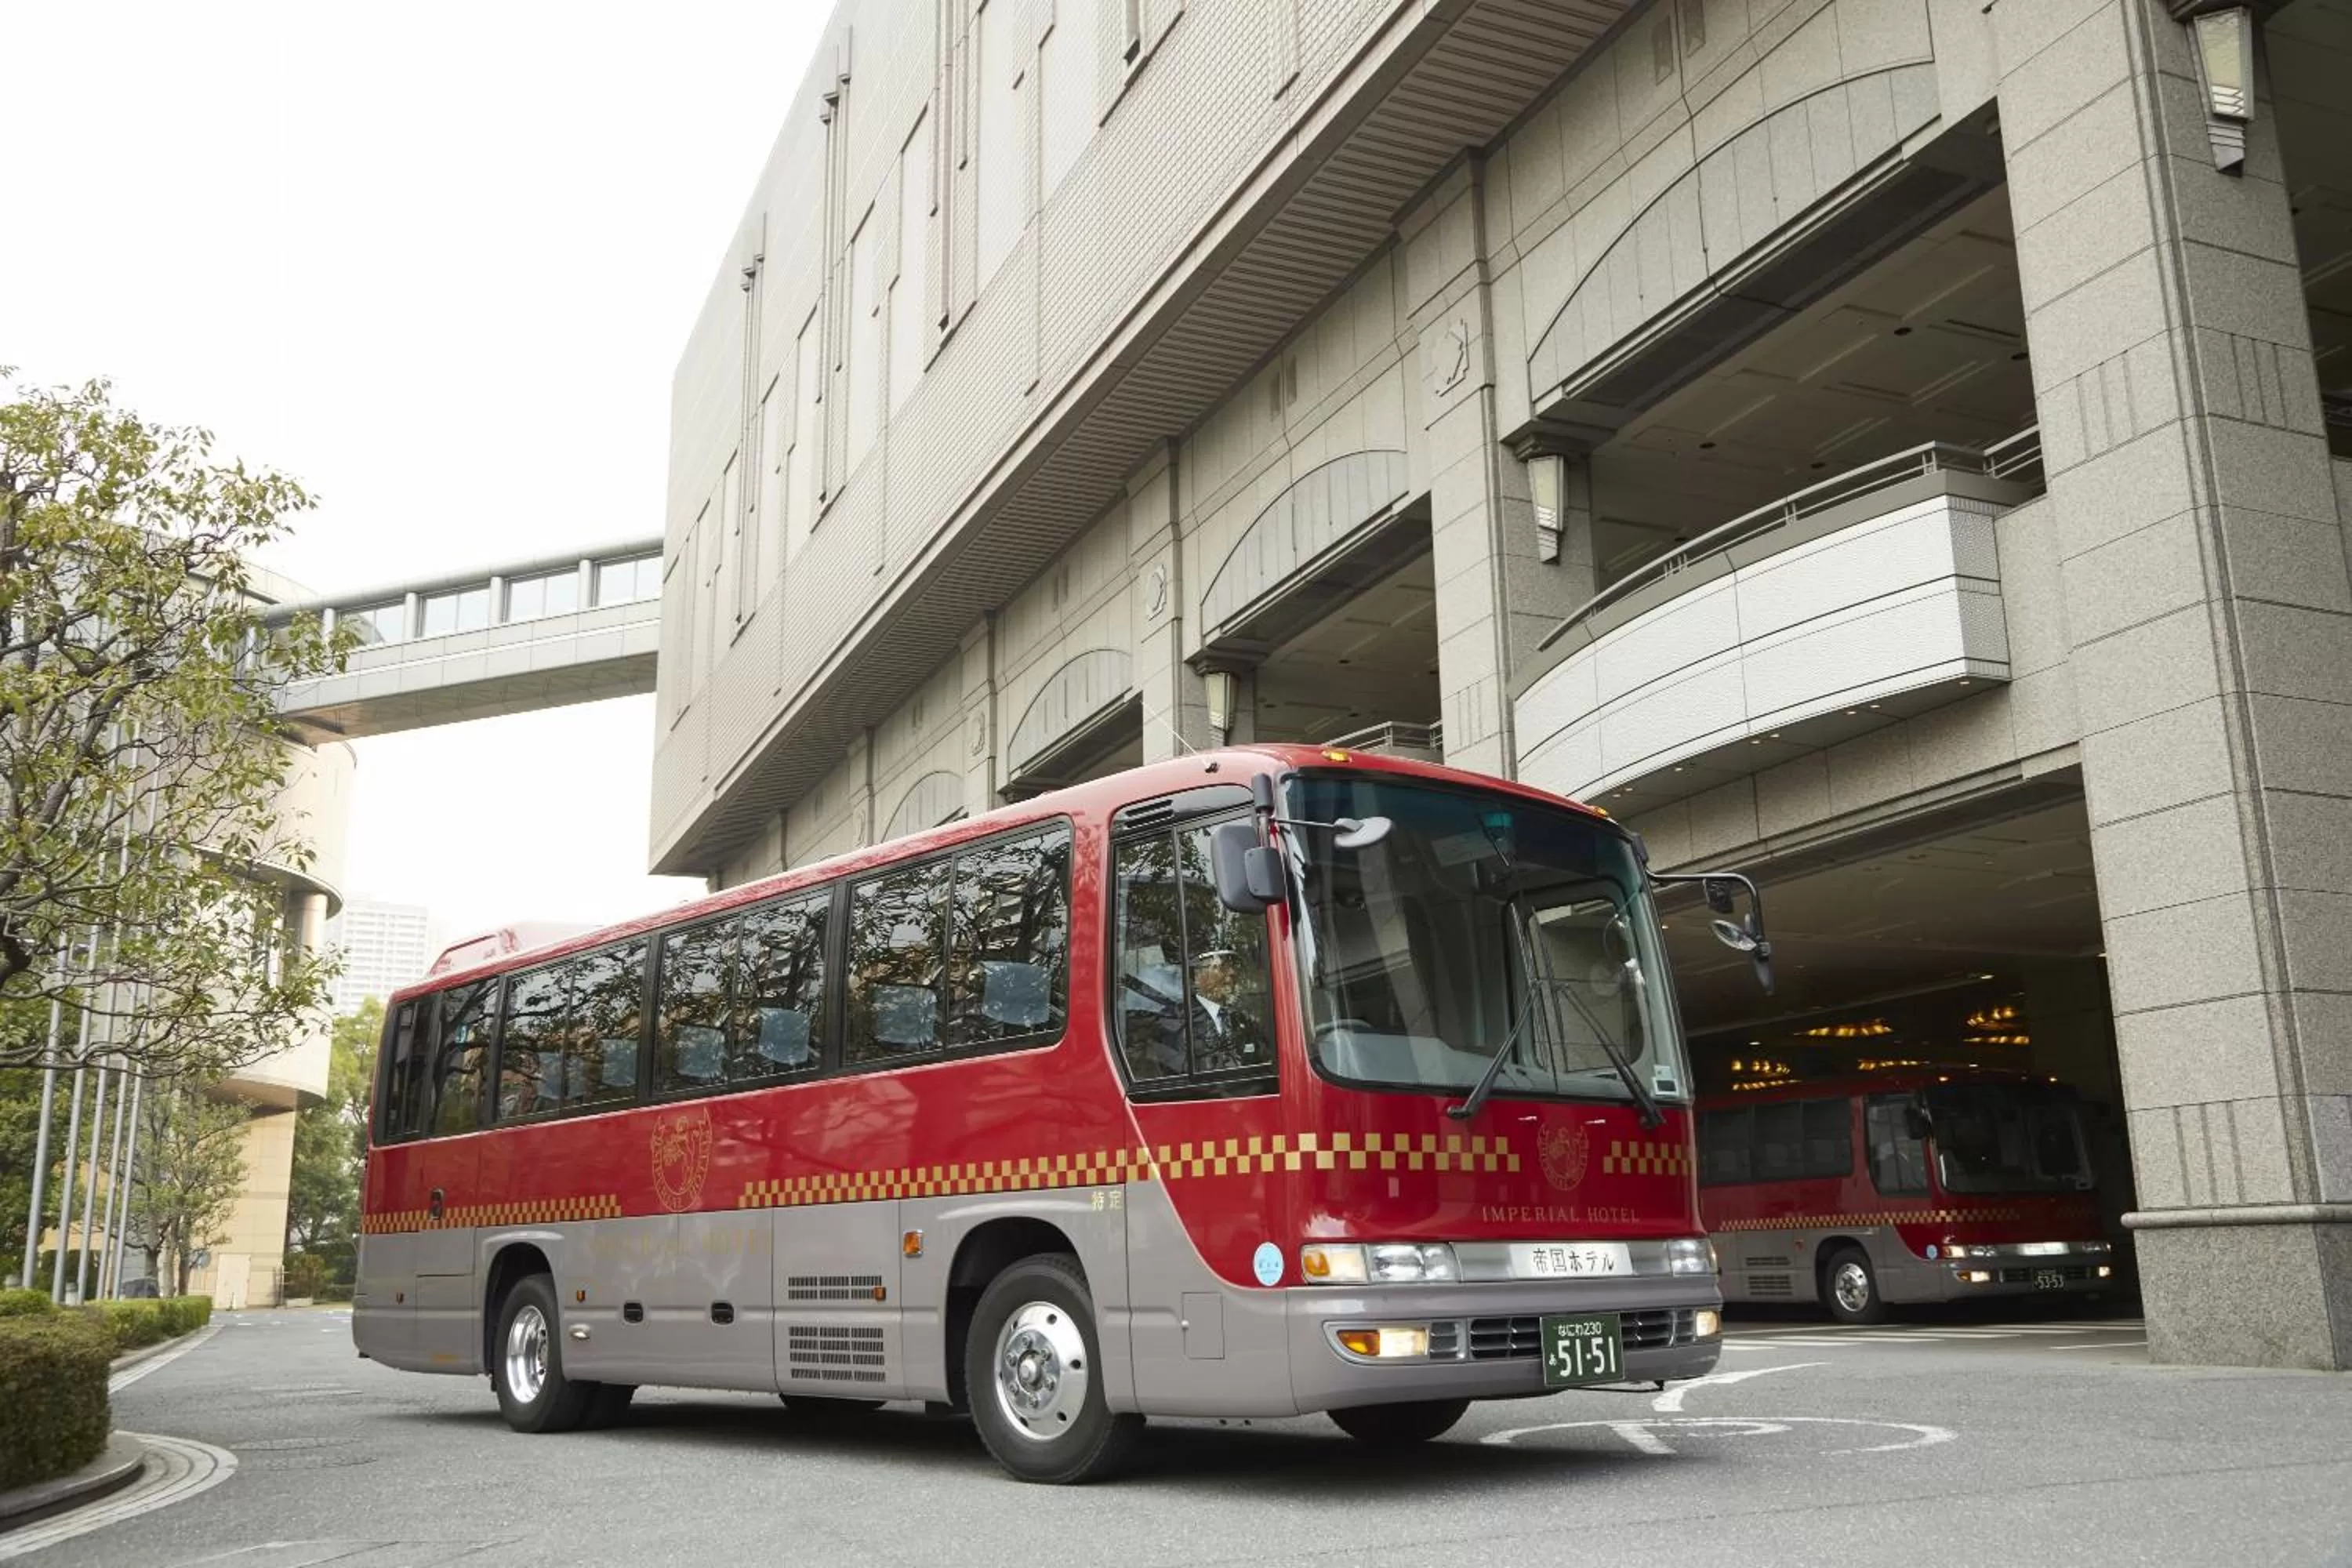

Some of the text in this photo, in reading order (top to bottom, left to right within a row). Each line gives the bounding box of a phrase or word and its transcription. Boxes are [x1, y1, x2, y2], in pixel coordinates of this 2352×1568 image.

[1483, 1207, 1640, 1223] IMPERIAL HOTEL
[1533, 1248, 1614, 1273] 帝国ホテル
